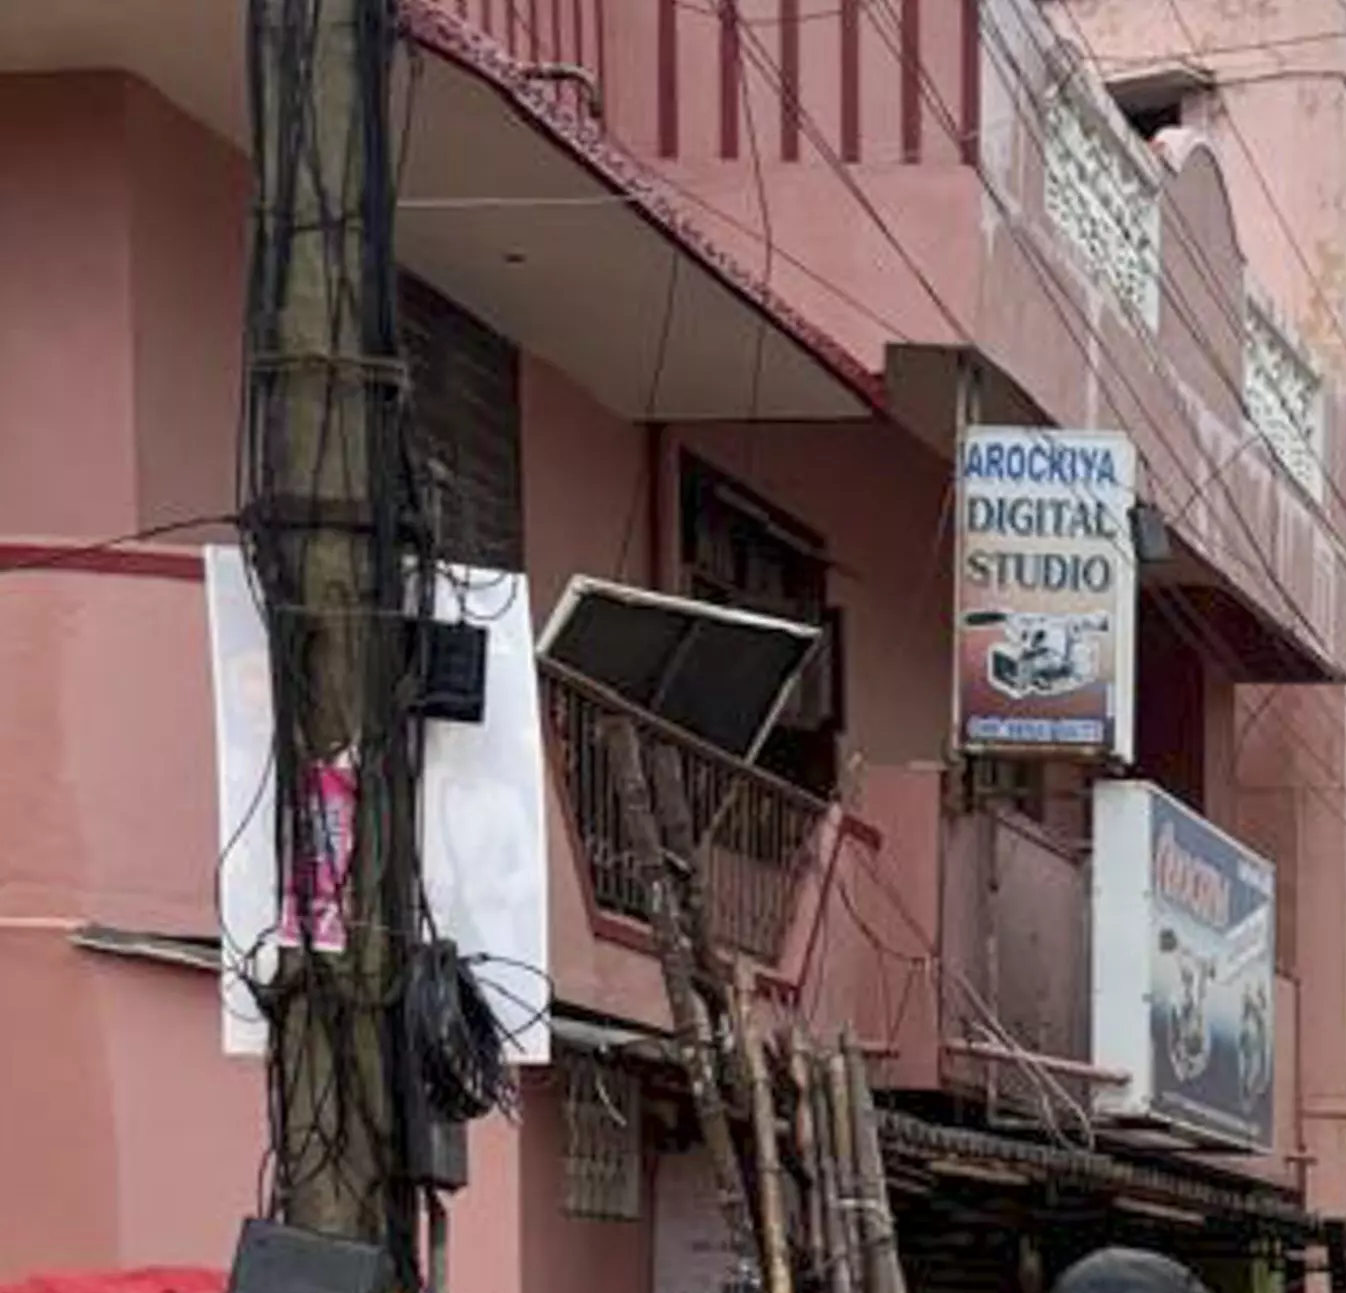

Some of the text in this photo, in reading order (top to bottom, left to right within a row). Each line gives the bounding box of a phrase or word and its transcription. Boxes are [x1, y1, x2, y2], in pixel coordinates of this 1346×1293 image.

[964, 441, 1117, 484] AROCKIYA
[967, 495, 1118, 539] DIGITAL
[967, 551, 1111, 593] STUDIO
